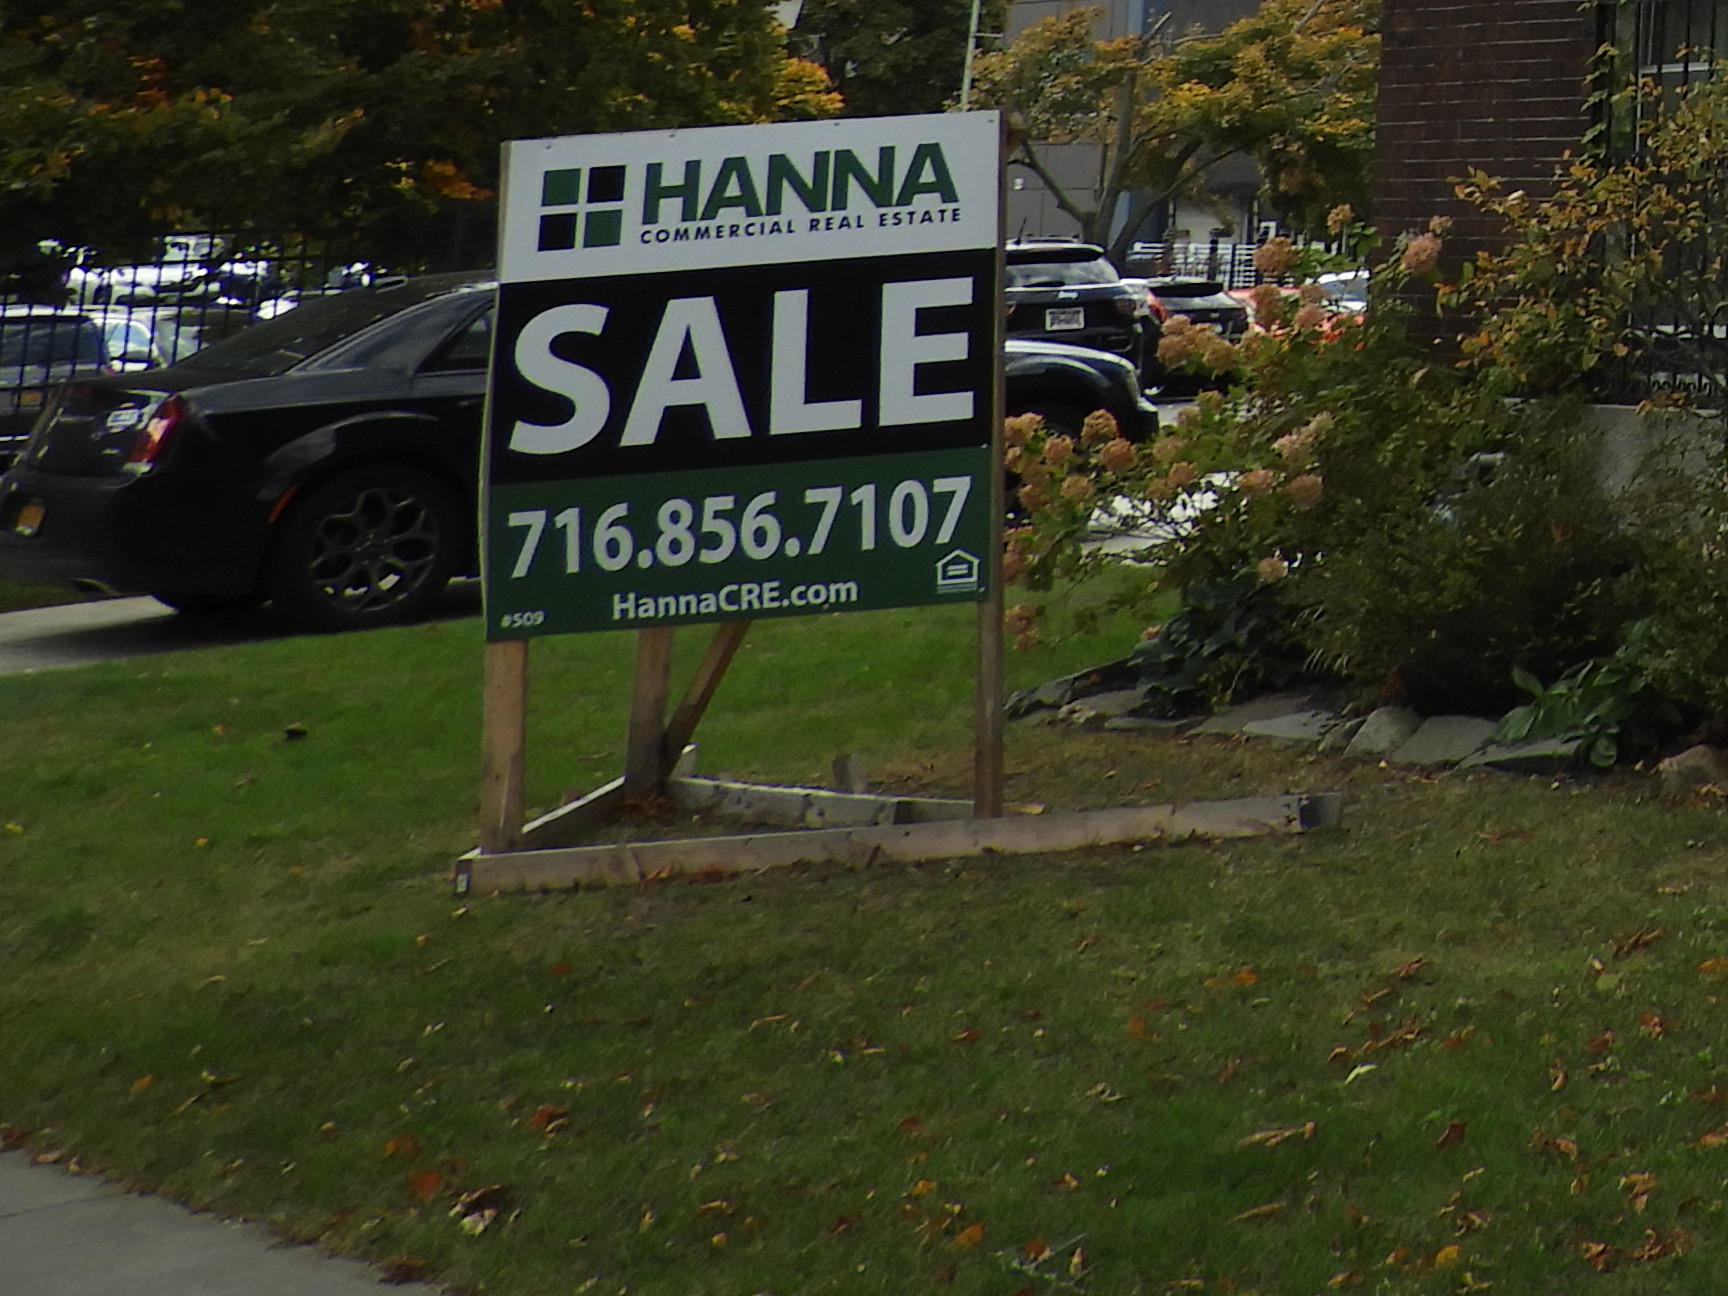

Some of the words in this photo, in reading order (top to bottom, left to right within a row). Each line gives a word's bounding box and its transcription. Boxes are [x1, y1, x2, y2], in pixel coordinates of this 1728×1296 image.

[641, 142, 960, 225] HANNA
[640, 219, 796, 245] COMMERCIAL
[809, 214, 865, 233] REAL
[878, 207, 963, 228] ESTATE
[508, 276, 975, 455] SALE
[507, 475, 973, 579] 716.856.7107
[612, 580, 859, 621] HannaCRE.com
